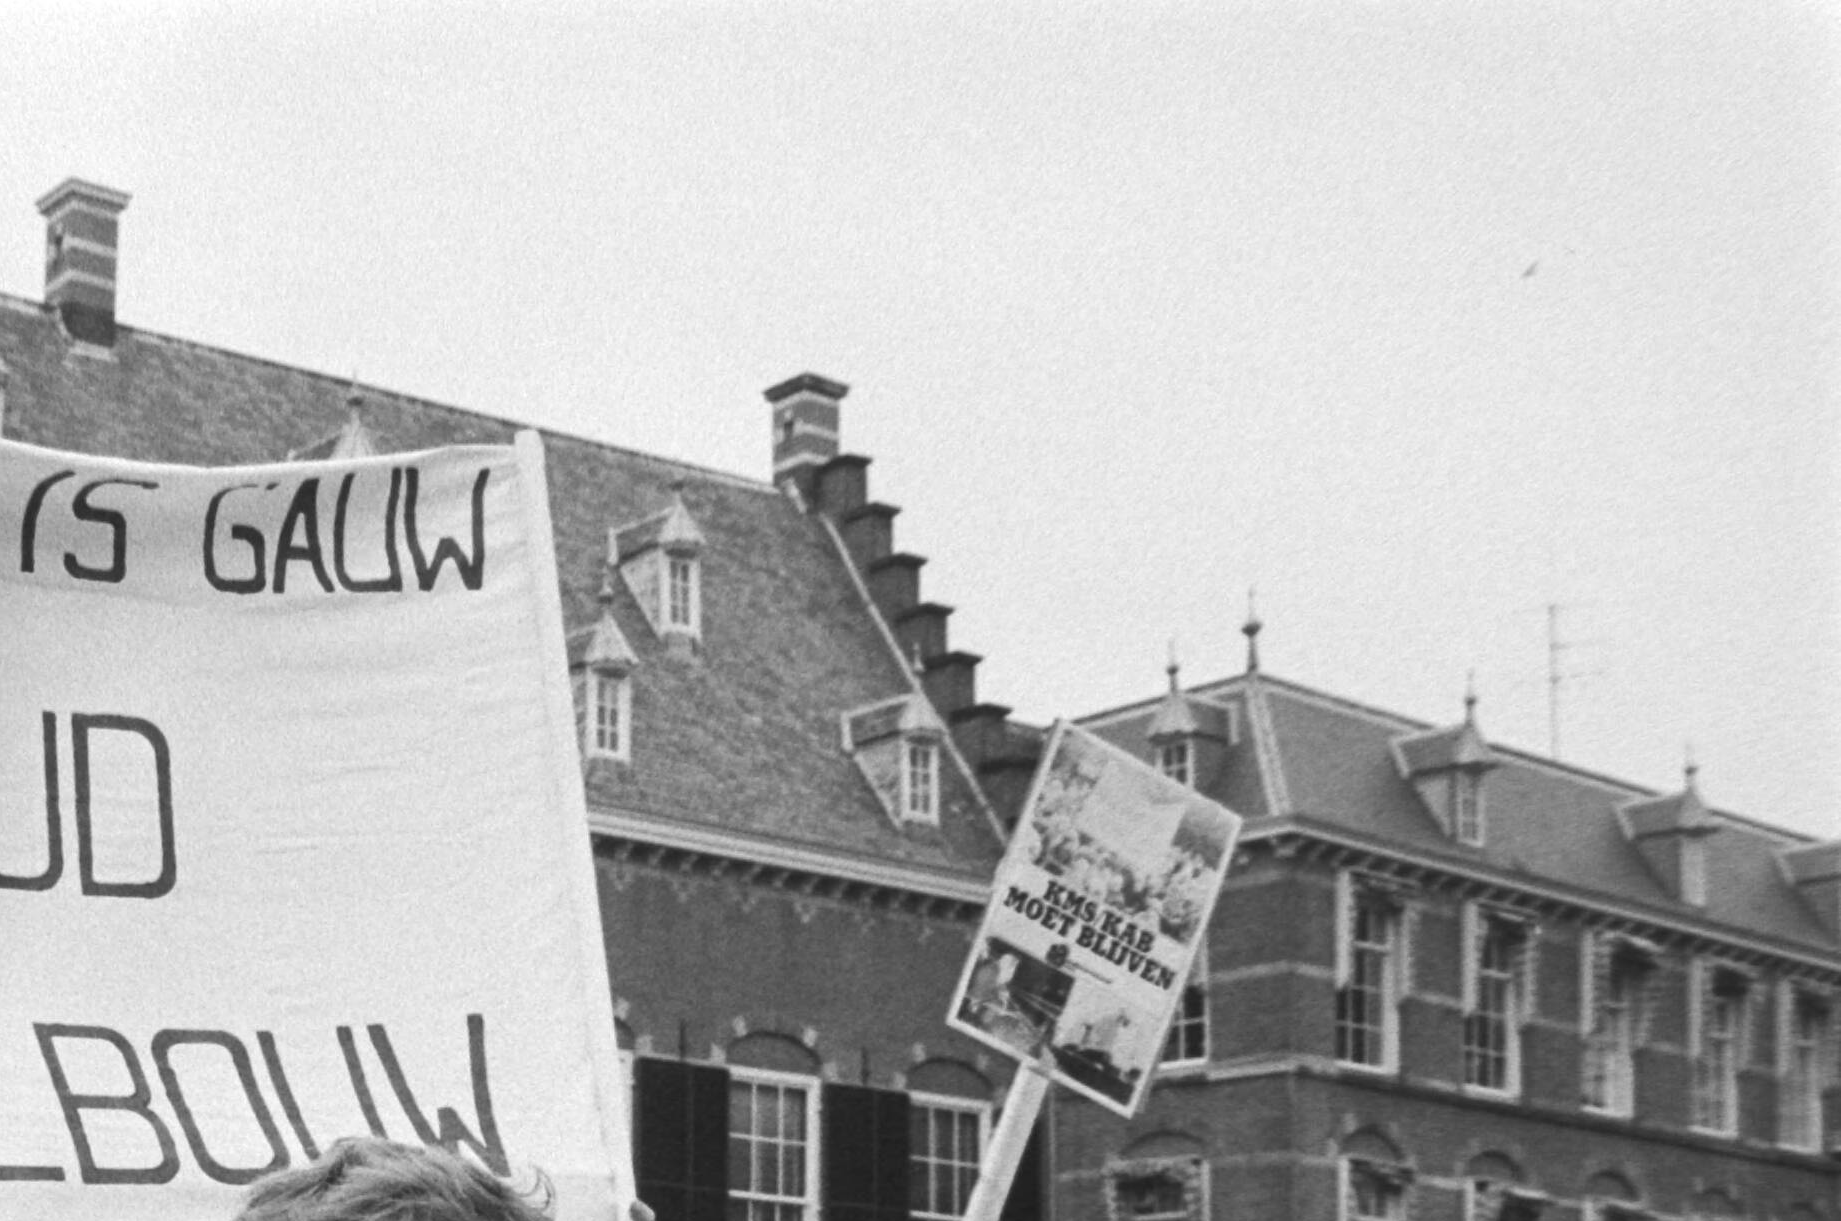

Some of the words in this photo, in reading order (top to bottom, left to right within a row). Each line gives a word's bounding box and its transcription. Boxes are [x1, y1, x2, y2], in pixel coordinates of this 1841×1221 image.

[203, 466, 491, 594] GAUW
[1003, 886, 1077, 937] MOET
[1076, 924, 1176, 991] BLIJVEN
